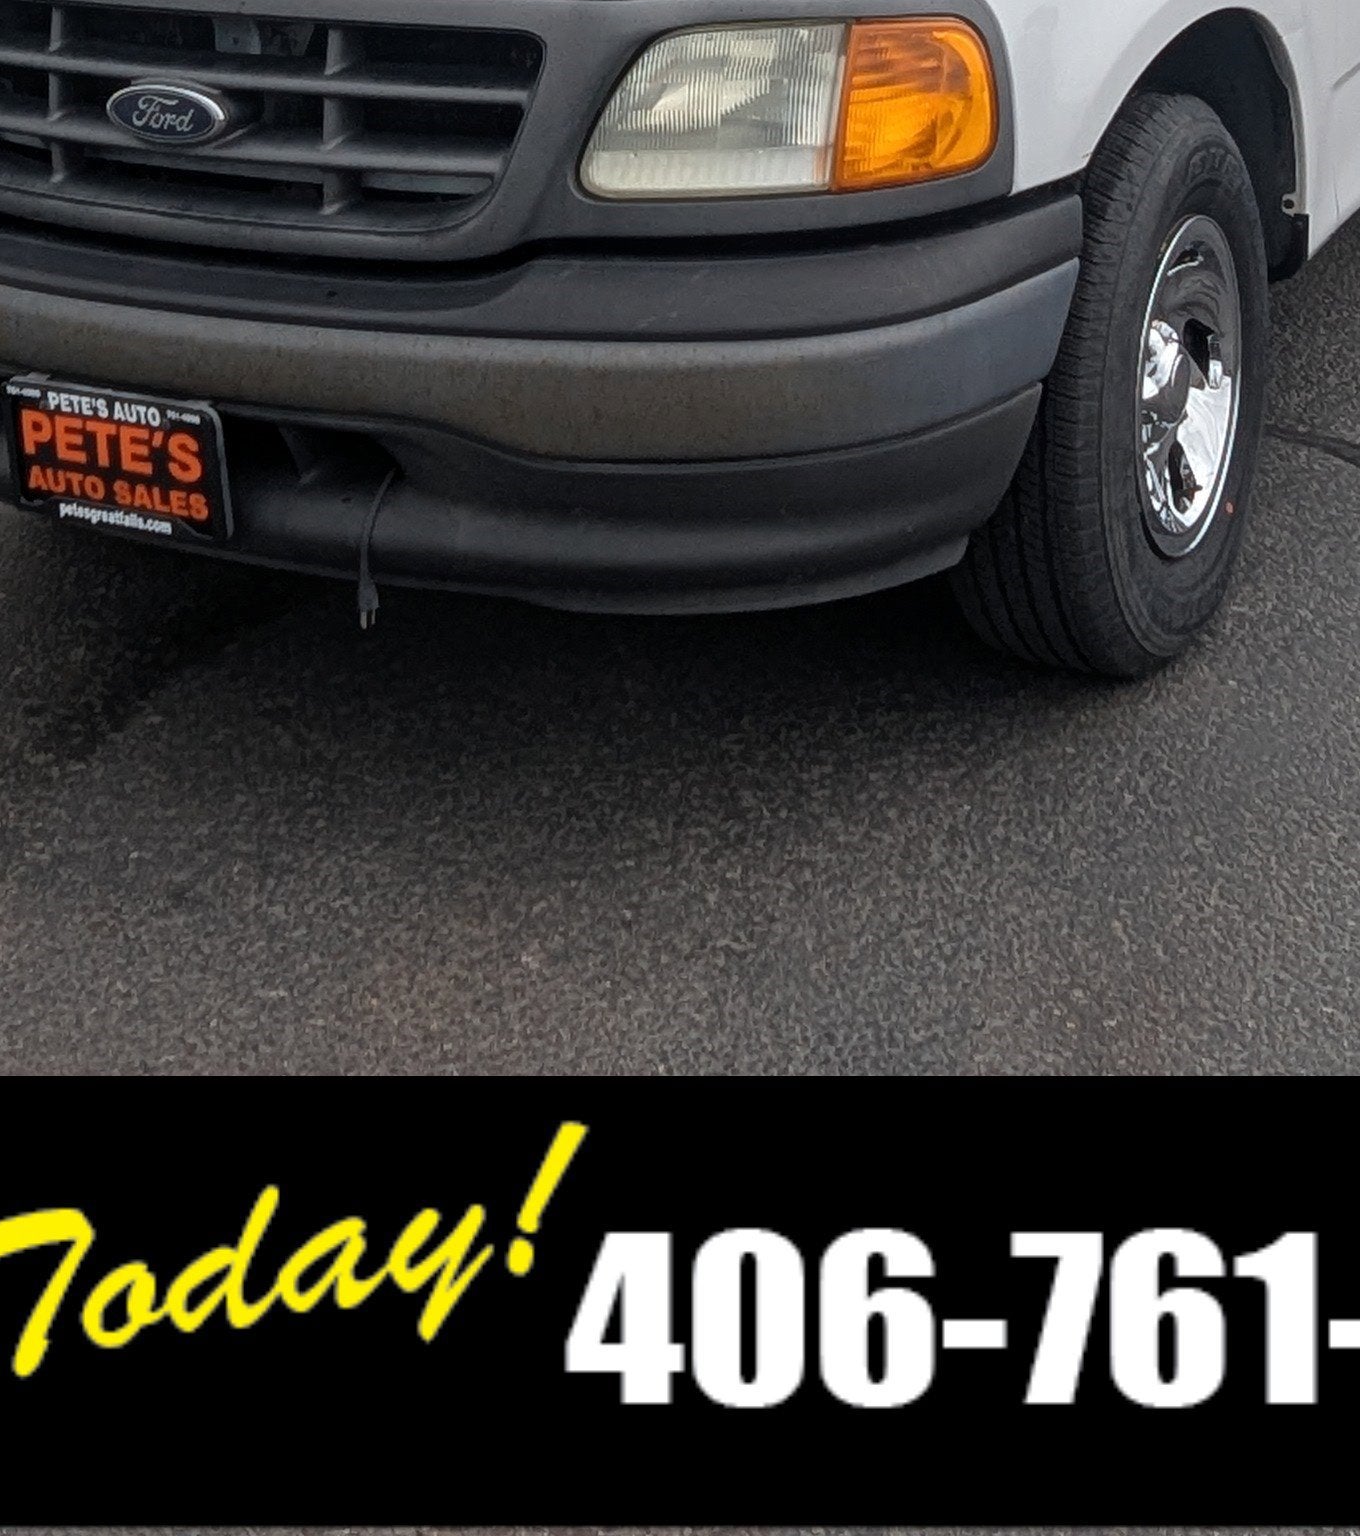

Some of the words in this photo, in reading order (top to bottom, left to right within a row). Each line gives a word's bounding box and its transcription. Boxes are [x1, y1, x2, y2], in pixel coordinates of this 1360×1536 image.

[132, 94, 195, 132] Ford
[46, 390, 109, 419] PETE'S
[113, 401, 162, 427] AUTO
[20, 408, 203, 483] PETE'S
[28, 465, 106, 501] AUTO
[113, 479, 209, 522] SALES
